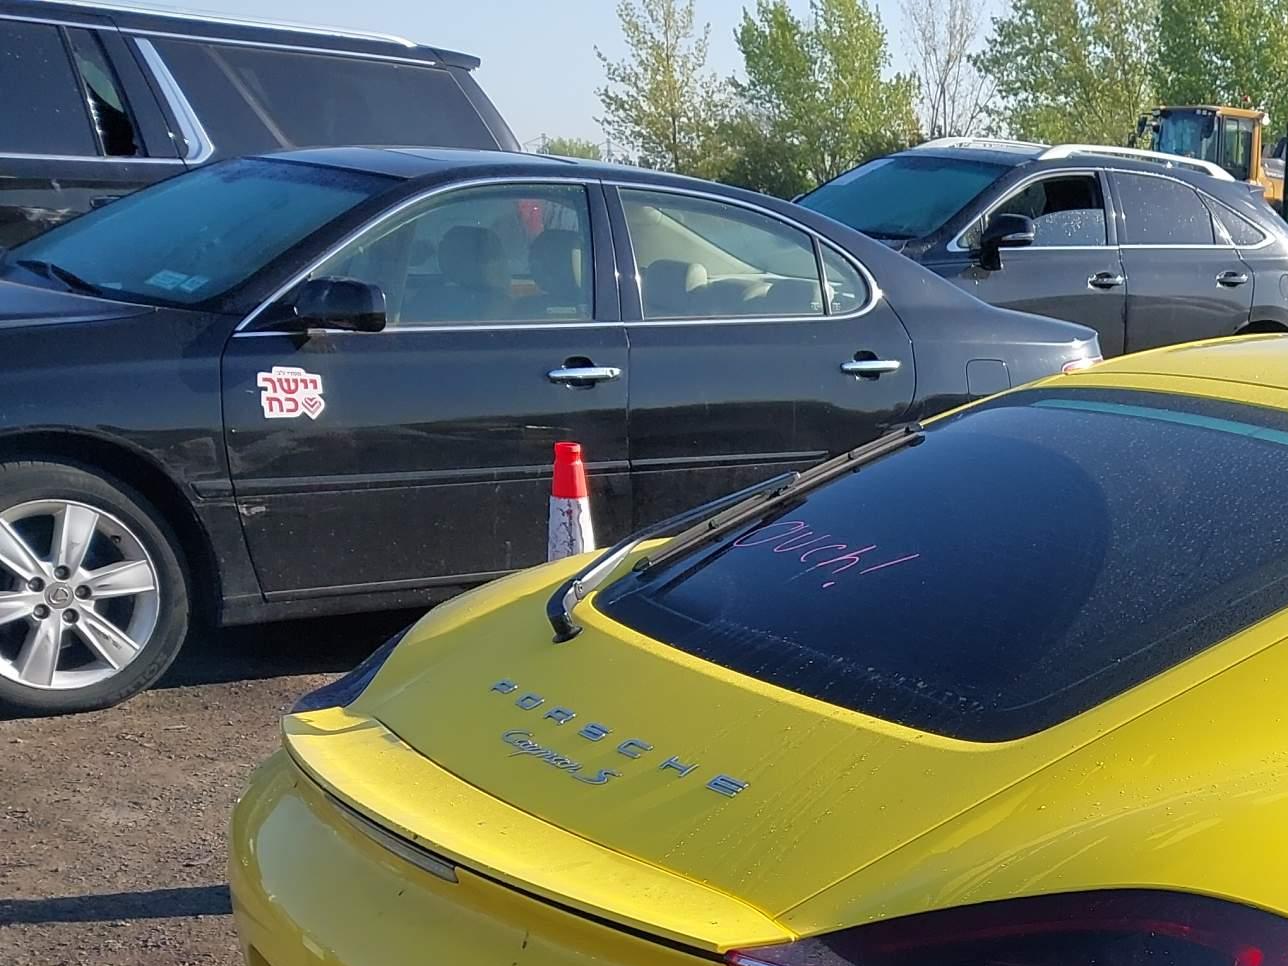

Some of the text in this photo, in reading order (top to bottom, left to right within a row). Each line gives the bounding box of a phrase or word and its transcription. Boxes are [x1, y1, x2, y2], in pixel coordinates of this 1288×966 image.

[262, 377, 318, 394] יישר
[266, 396, 299, 413] כח
[489, 677, 751, 799] PORSCHE
